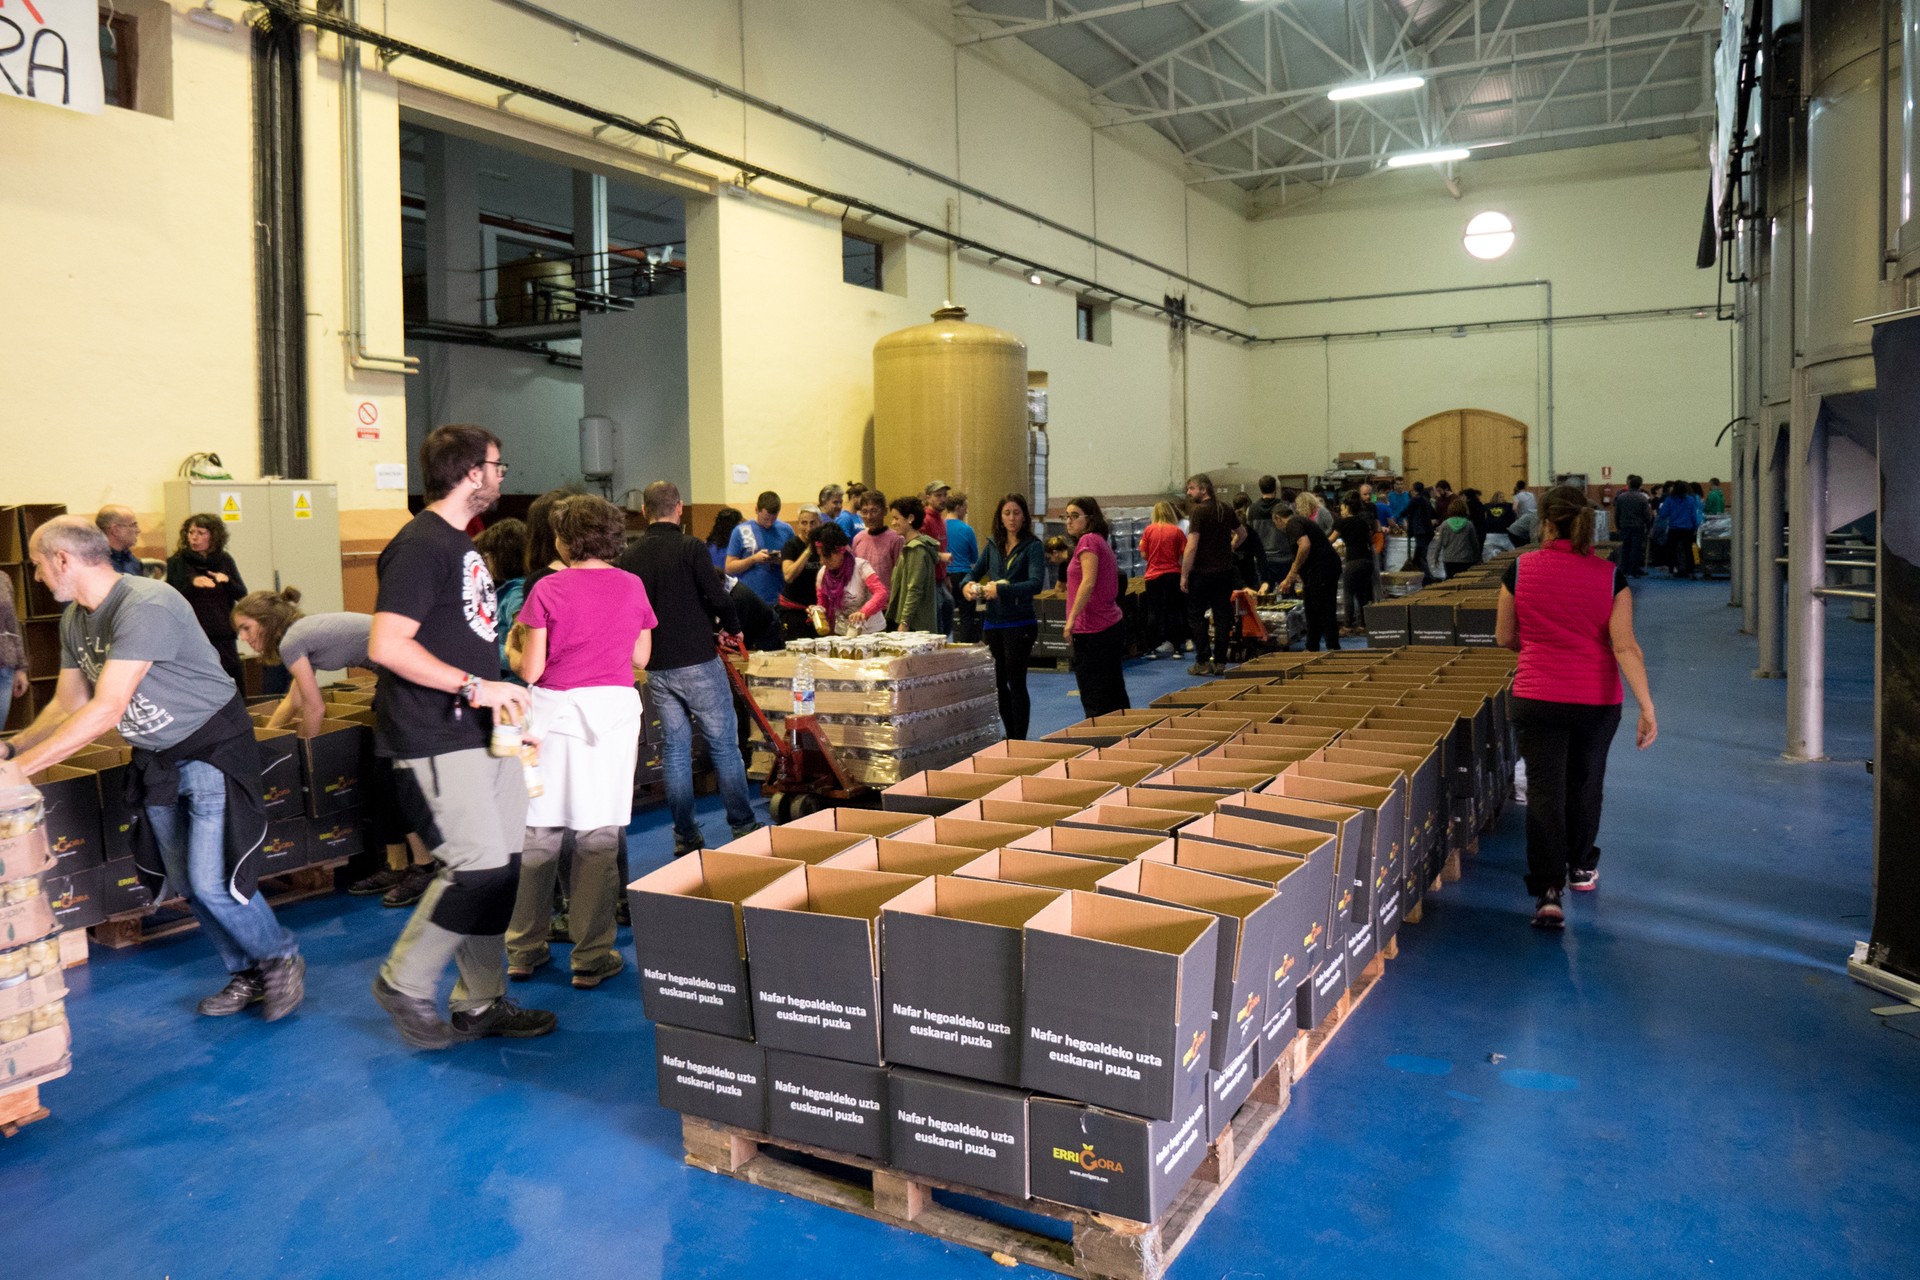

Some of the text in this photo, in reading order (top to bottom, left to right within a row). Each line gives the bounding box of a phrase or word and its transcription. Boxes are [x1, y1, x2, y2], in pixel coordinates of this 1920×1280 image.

[644, 968, 737, 994] Nafar hegoaldeko uzta
[659, 986, 724, 1006] euskarari puzka
[759, 991, 867, 1017] Nafar hegoaldeko uzta
[776, 1009, 852, 1031] euskarari puzka
[892, 1003, 1011, 1035] Nafar hegoaldeko uzta
[910, 1023, 993, 1049] euskarari puzka
[1031, 1027, 1064, 1045] Nafar
[1064, 1034, 1134, 1061] hegoaldeko
[1135, 1052, 1163, 1067] uzta
[662, 1055, 757, 1085] Nafar hegoaldeko uzta
[1049, 1049, 1141, 1081] euskarari puzka
[676, 1074, 743, 1097] euskarari puzka
[774, 1080, 881, 1111] Nafar hegoaldeko uzta
[790, 1099, 865, 1125] euskarari puzka
[897, 1109, 1015, 1145] Nafar hegoaldeko uzta
[914, 1131, 997, 1159] euskarari puzka
[1053, 1144, 1125, 1174] ERRIGORA
